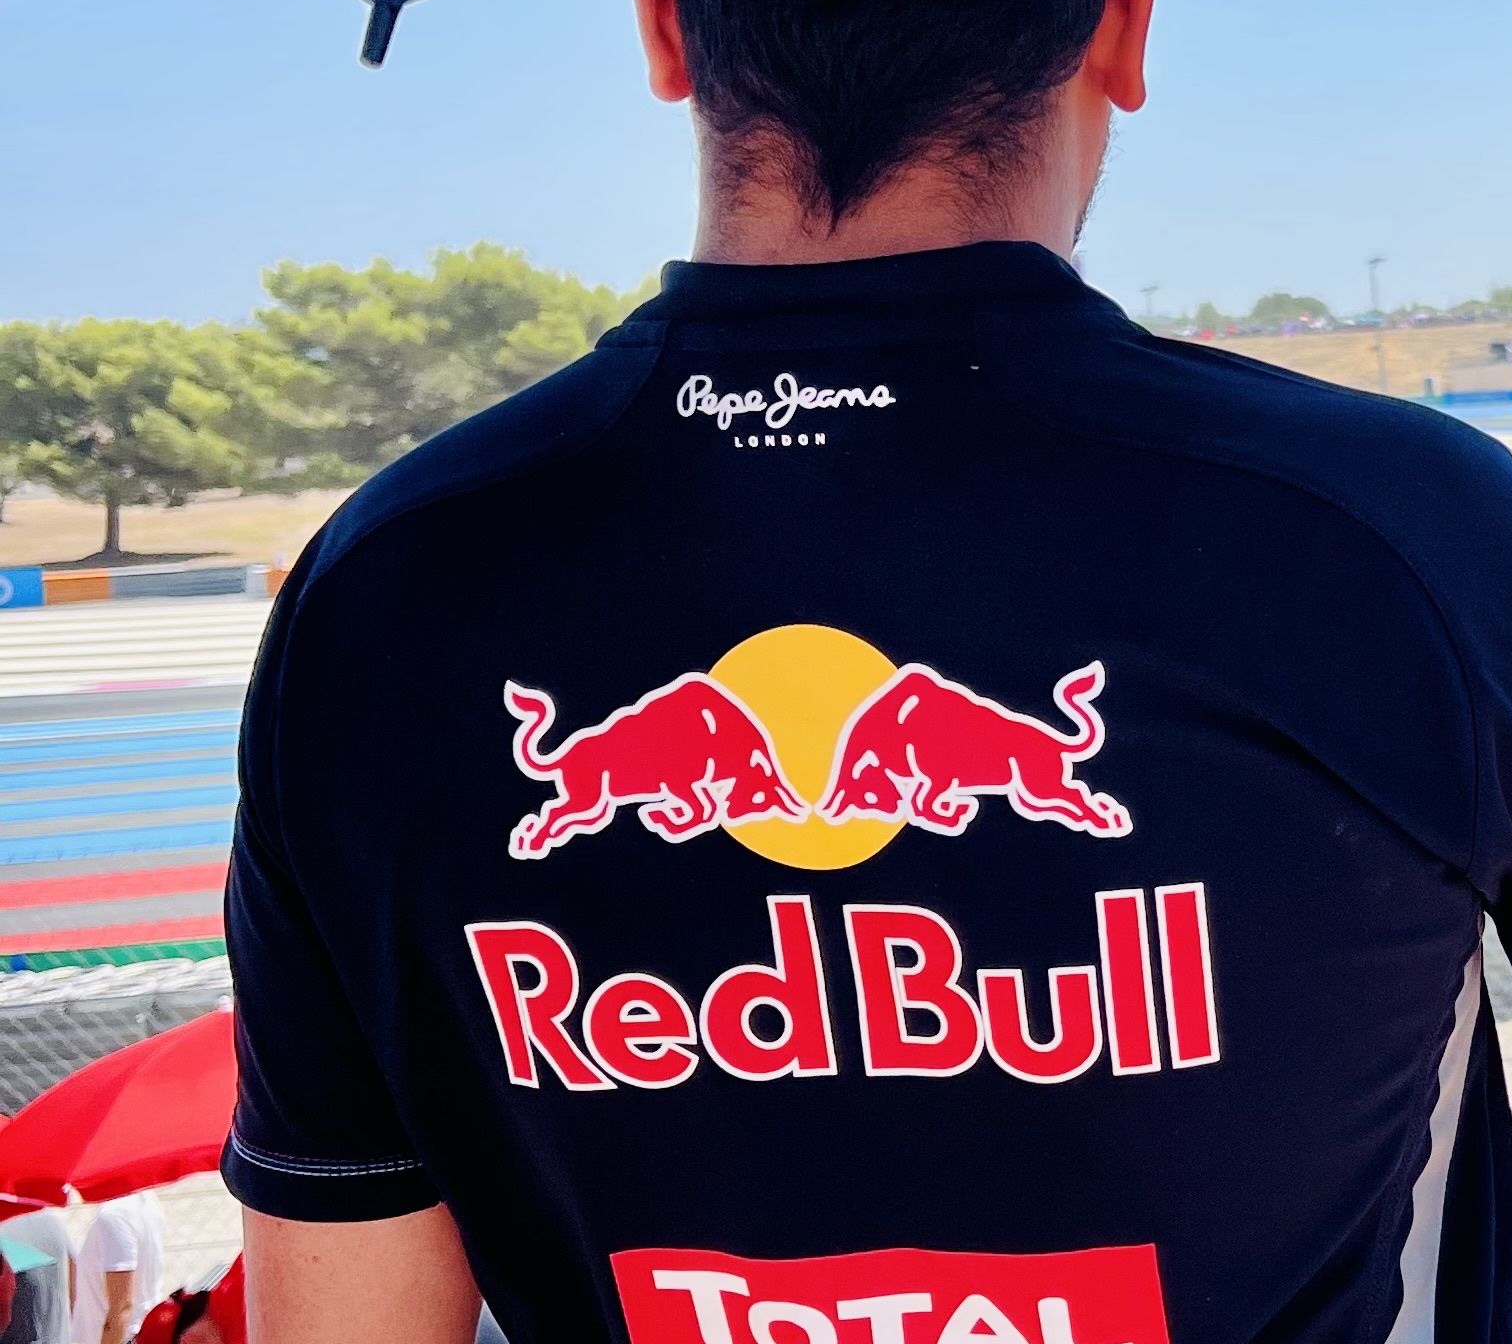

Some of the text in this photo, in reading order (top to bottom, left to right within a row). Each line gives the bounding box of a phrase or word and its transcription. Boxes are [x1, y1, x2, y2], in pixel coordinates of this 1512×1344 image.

[676, 372, 897, 431] Pepe Jeans
[734, 432, 826, 448] LONDON
[464, 881, 1220, 1093] Red Bull
